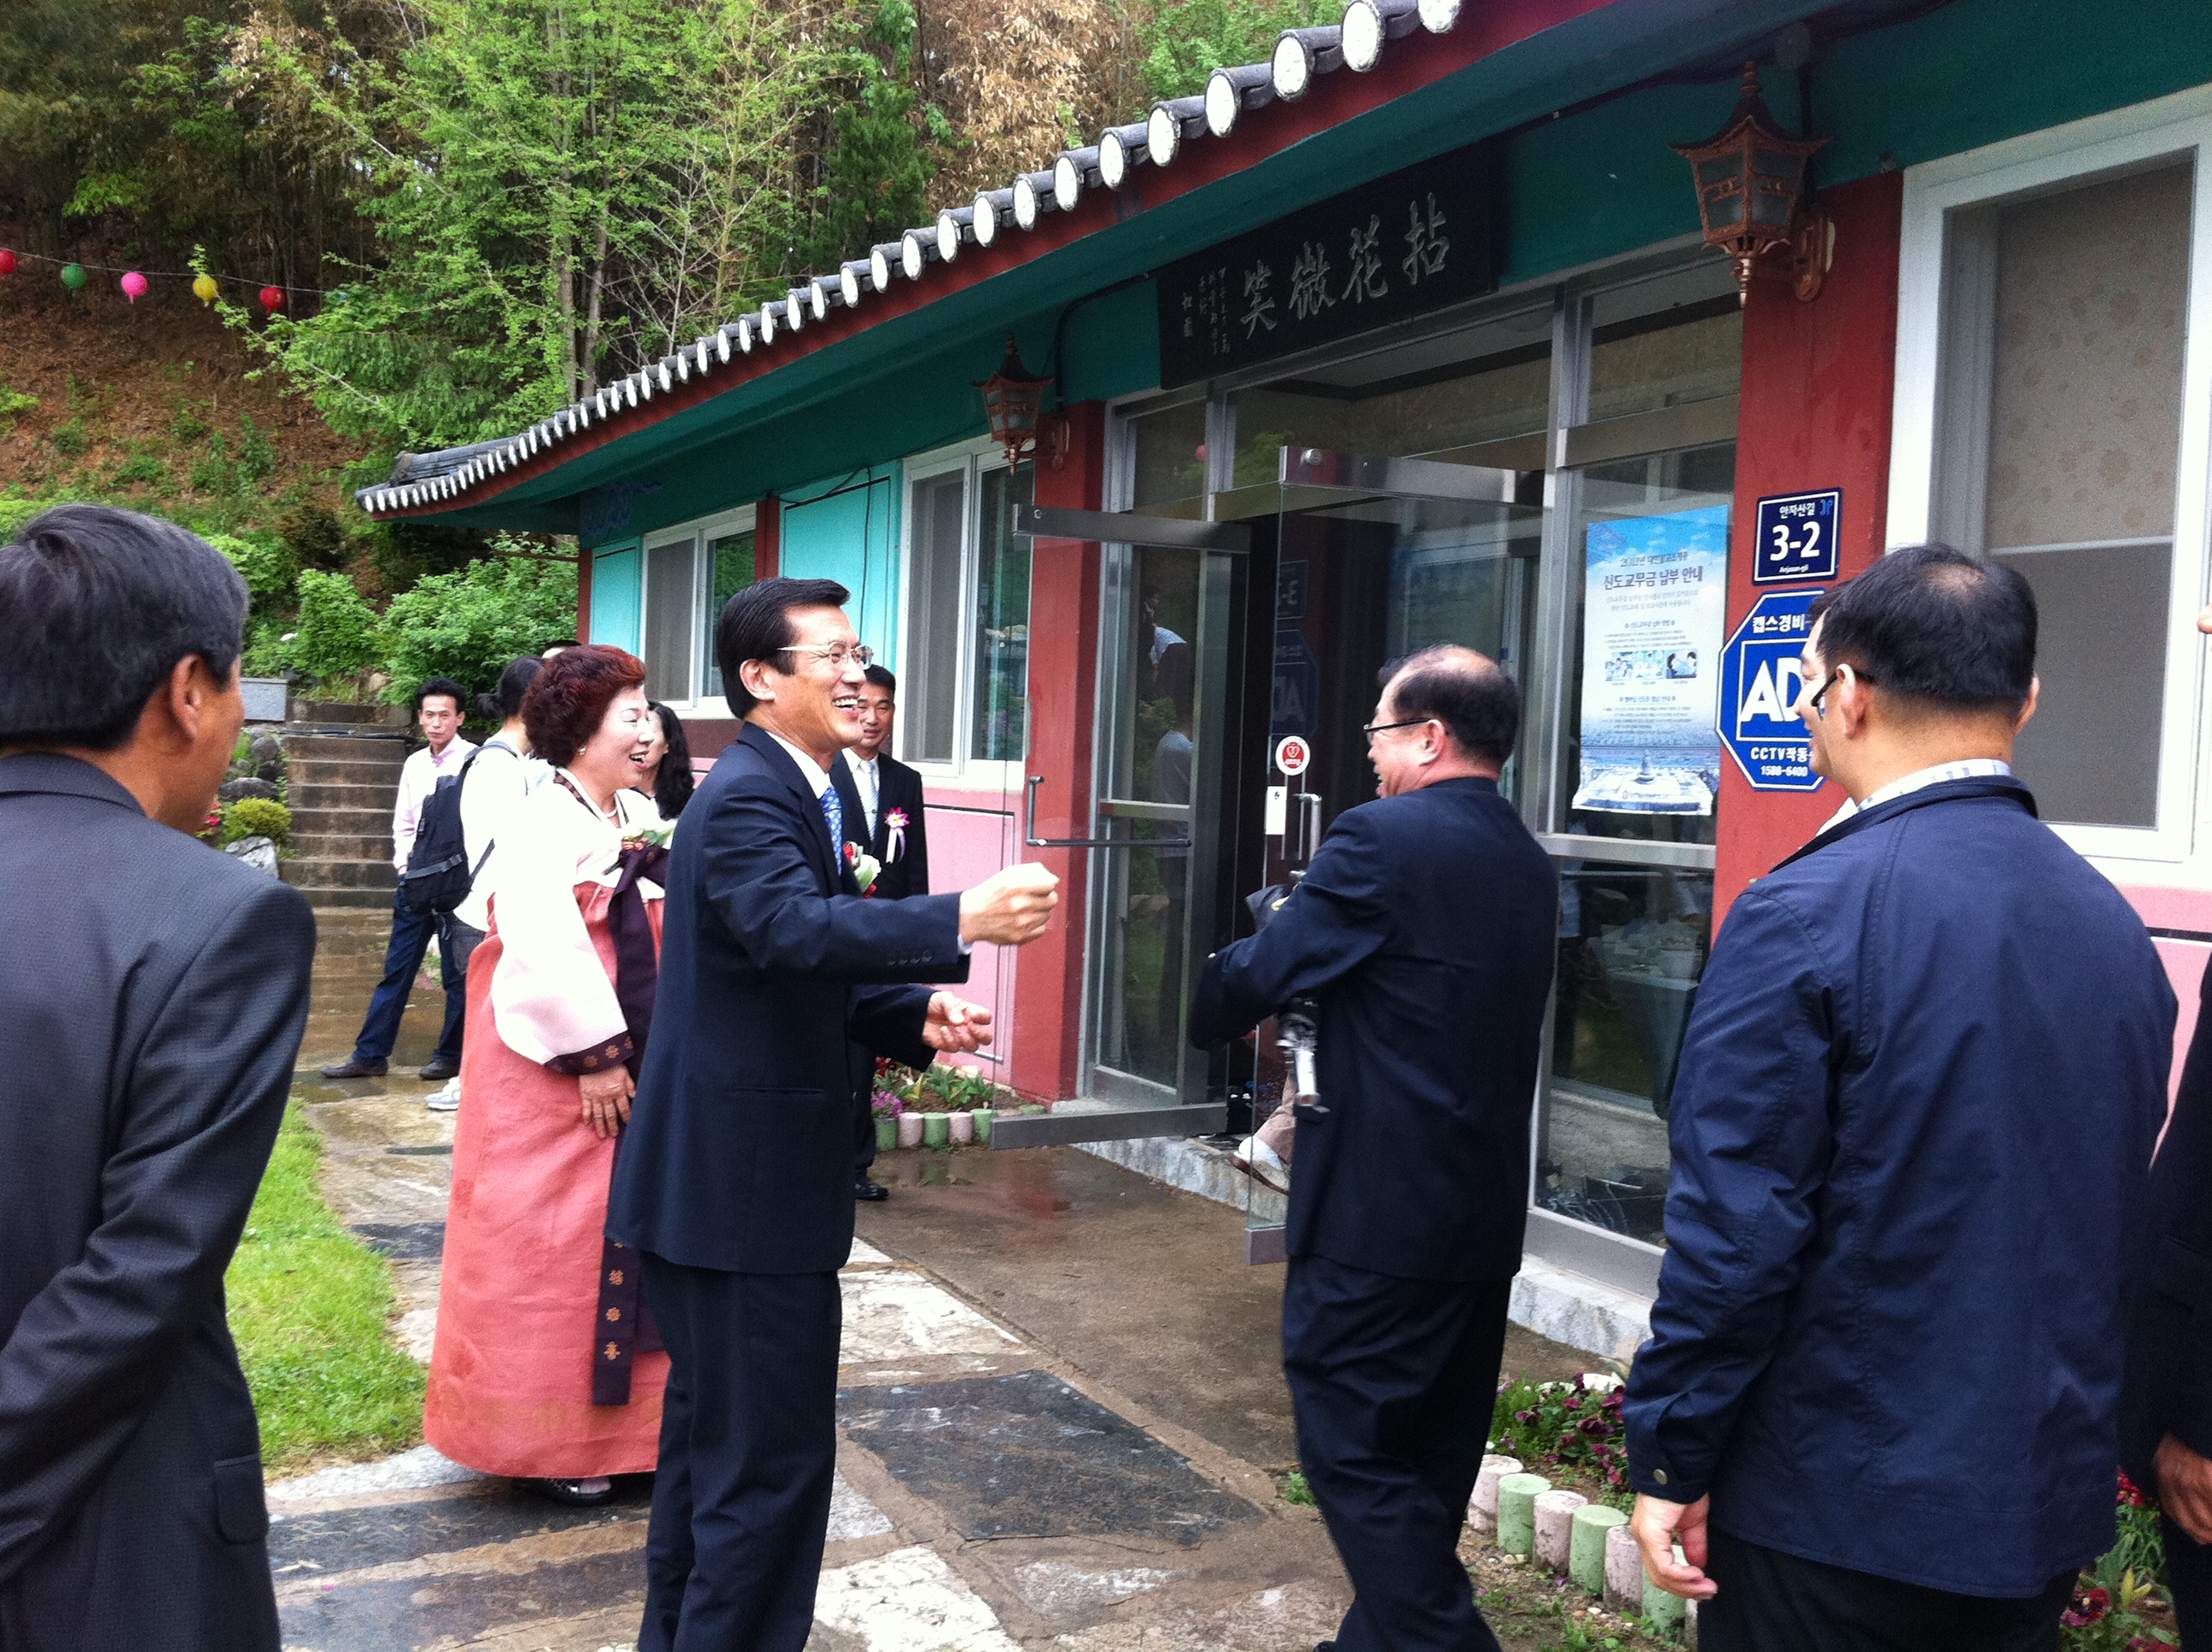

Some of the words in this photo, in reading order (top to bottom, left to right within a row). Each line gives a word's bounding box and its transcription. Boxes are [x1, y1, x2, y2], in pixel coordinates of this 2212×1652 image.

[1769, 521, 1820, 561] 3-2
[1604, 572, 1656, 590] 신도교무금
[1659, 568, 1679, 586] 납부
[1682, 565, 1703, 584] 안내
[1740, 657, 1805, 724] AD
